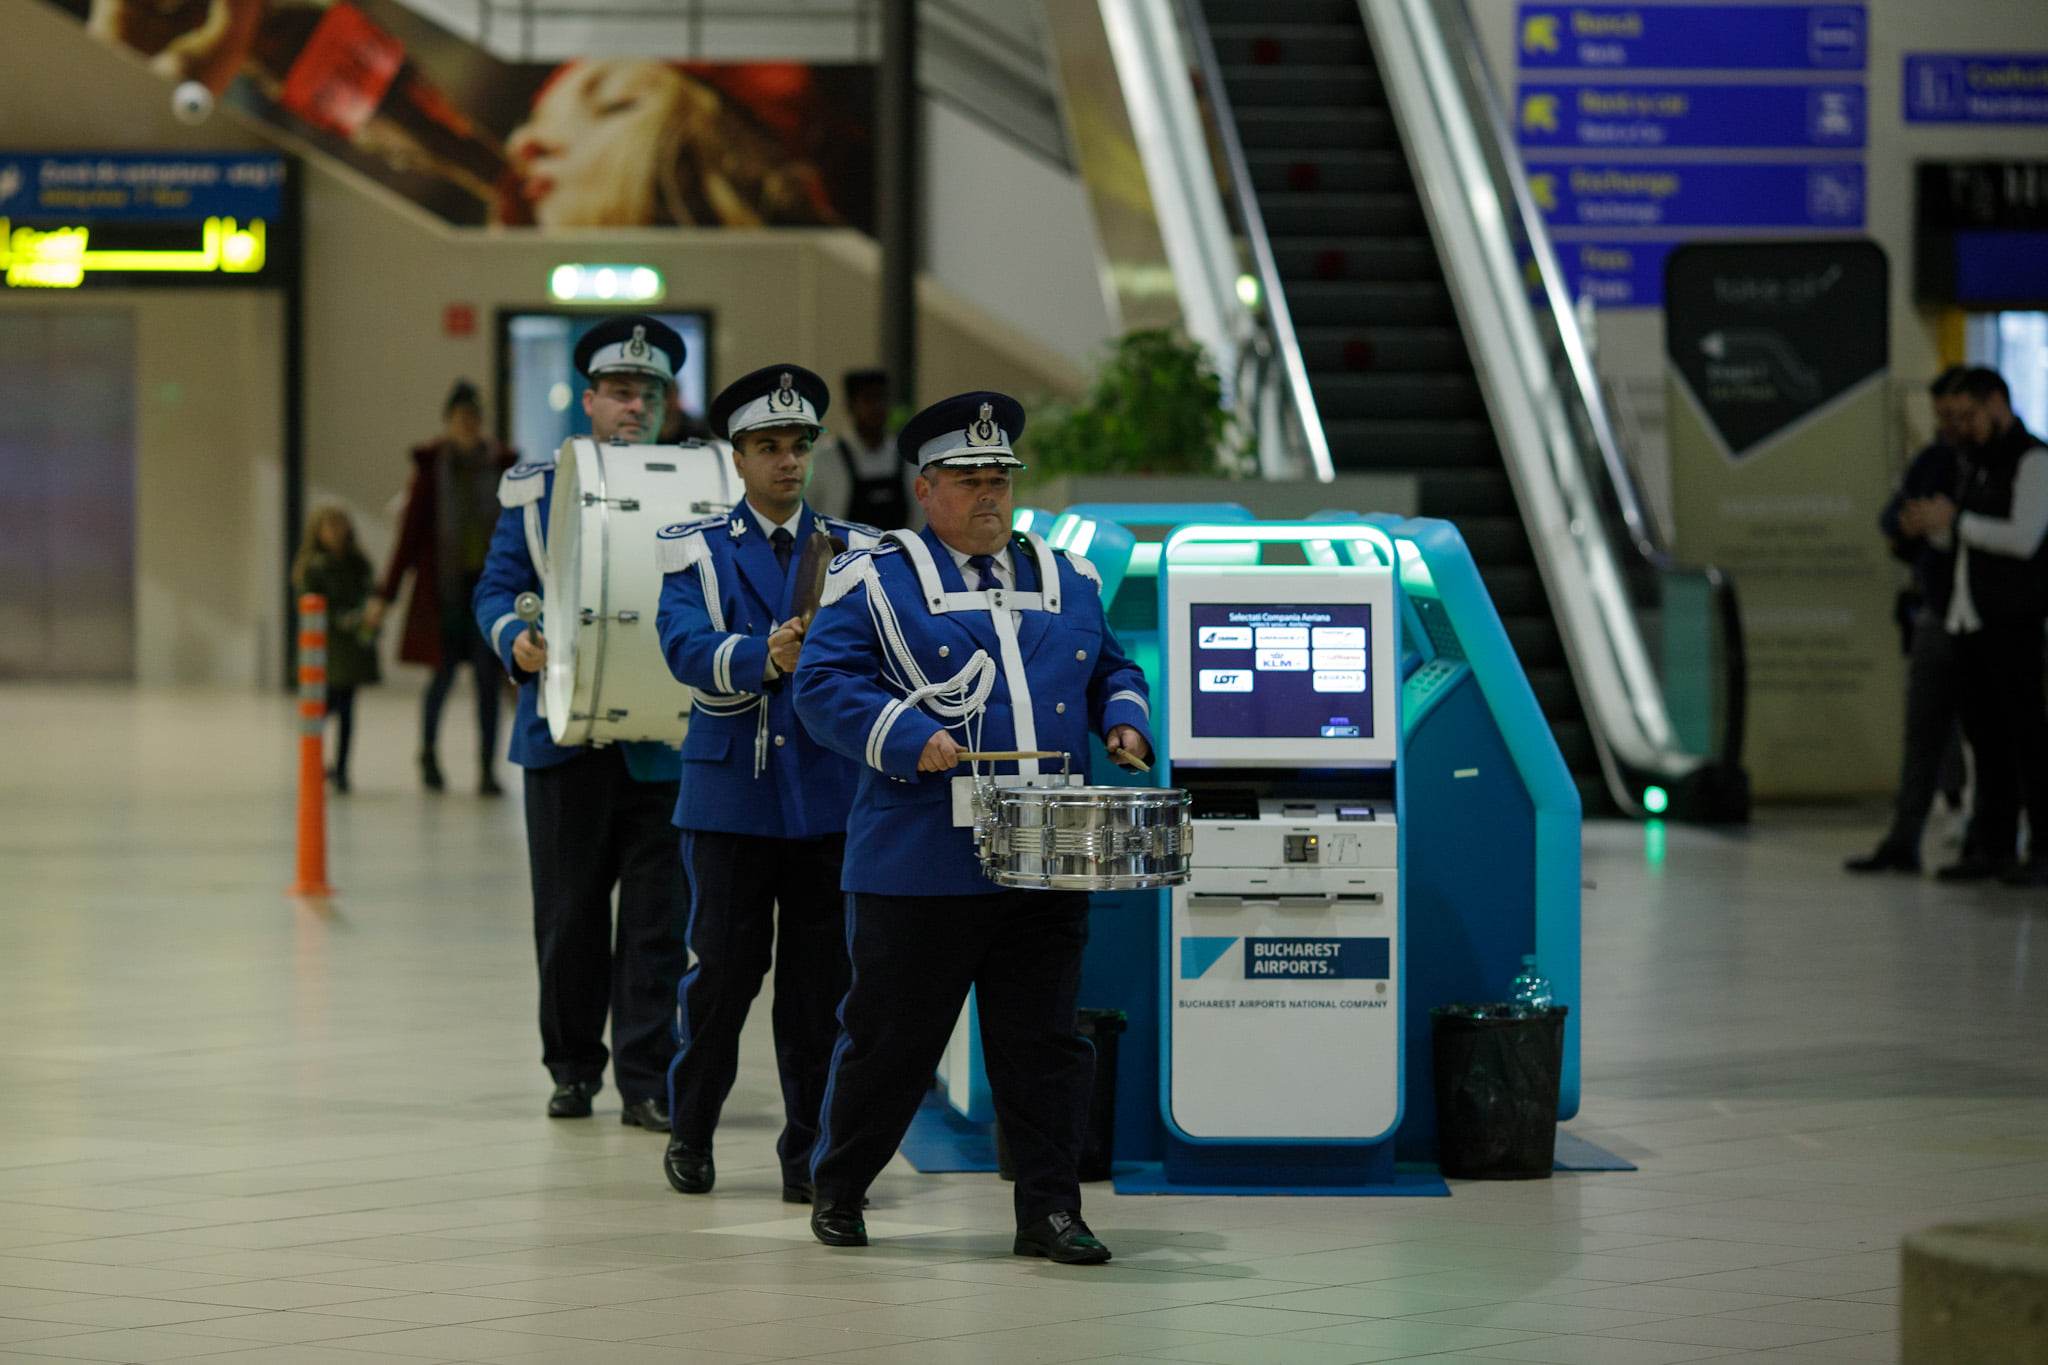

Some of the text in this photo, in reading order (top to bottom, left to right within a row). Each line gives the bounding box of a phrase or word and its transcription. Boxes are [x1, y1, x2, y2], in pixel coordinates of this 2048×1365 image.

[1262, 612, 1300, 623] Compania
[1302, 612, 1331, 622] Aeriana
[1213, 675, 1239, 684] LOT
[1254, 943, 1341, 957] BUCHAREST
[1254, 960, 1328, 974] AIRPORTS
[1178, 1000, 1388, 1009] BUCHAREST AIRPORTS NATIONAL COMPANY
